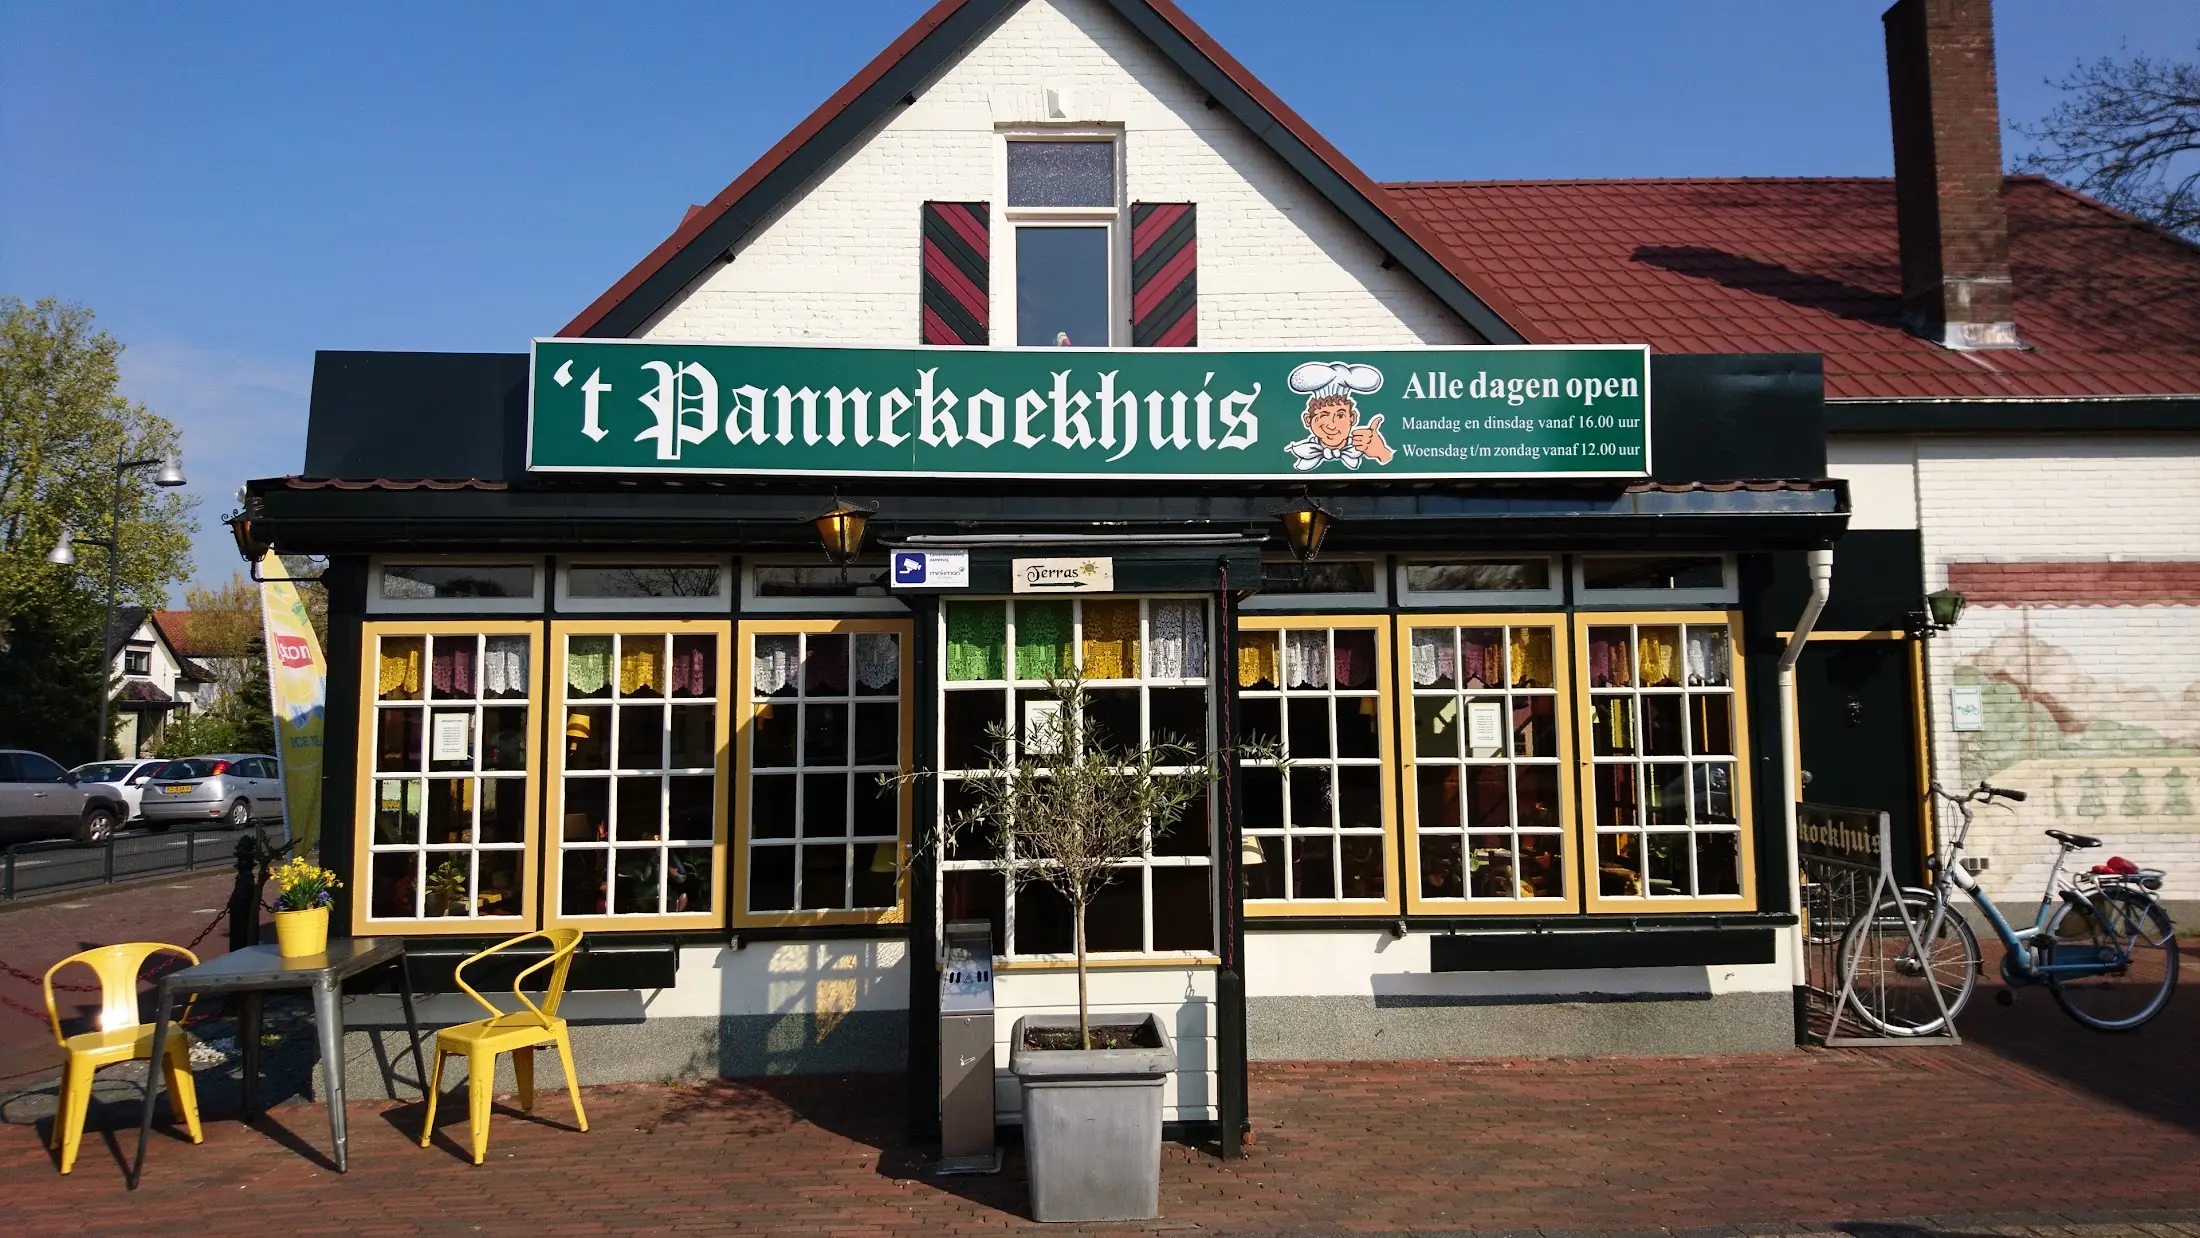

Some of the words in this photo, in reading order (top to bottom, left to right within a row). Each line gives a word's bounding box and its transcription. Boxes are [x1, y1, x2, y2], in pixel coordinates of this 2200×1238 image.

[1401, 371, 1464, 399] Alle
[1469, 371, 1560, 407] dagen
[1565, 377, 1639, 406] open
[634, 360, 1262, 463] Pannekoekhuis
[1402, 416, 1461, 433] Maandag
[1464, 419, 1480, 429] en
[1484, 415, 1534, 432] dinsdag
[1538, 415, 1576, 429] vanaf
[1580, 415, 1614, 428] 16.00
[1618, 418, 1640, 428] uur
[1402, 443, 1468, 460] Woensdag
[1469, 445, 1491, 457] t/m
[1493, 443, 1541, 460] zondag
[1542, 442, 1580, 456] vanaf
[1582, 442, 1616, 456] 12.00
[1618, 446, 1641, 456] uur
[1026, 565, 1079, 582] Terras
